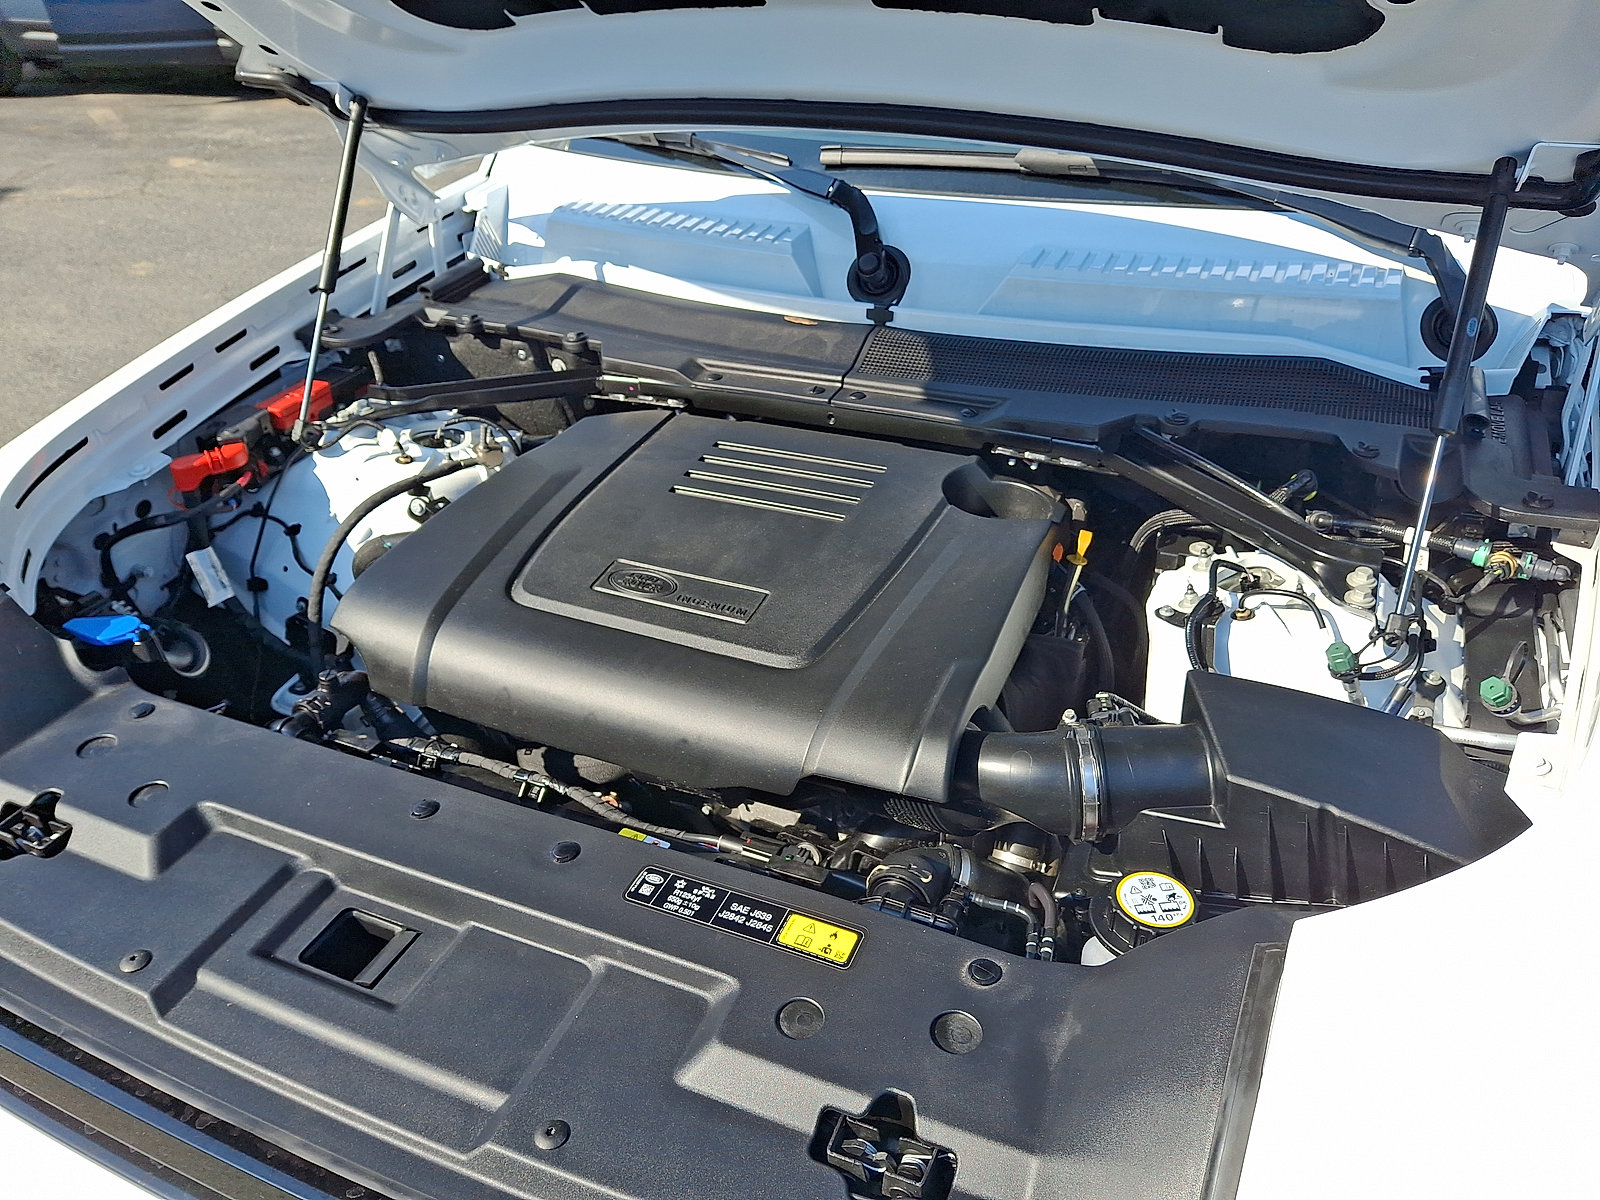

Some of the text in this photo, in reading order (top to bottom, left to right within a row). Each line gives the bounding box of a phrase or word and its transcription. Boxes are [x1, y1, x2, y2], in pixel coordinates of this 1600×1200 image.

[676, 594, 748, 616] INGENIUM
[718, 910, 746, 924] J2842
[745, 918, 774, 933] J2845
[730, 902, 773, 922] SAE J639
[1151, 913, 1174, 923] 140
